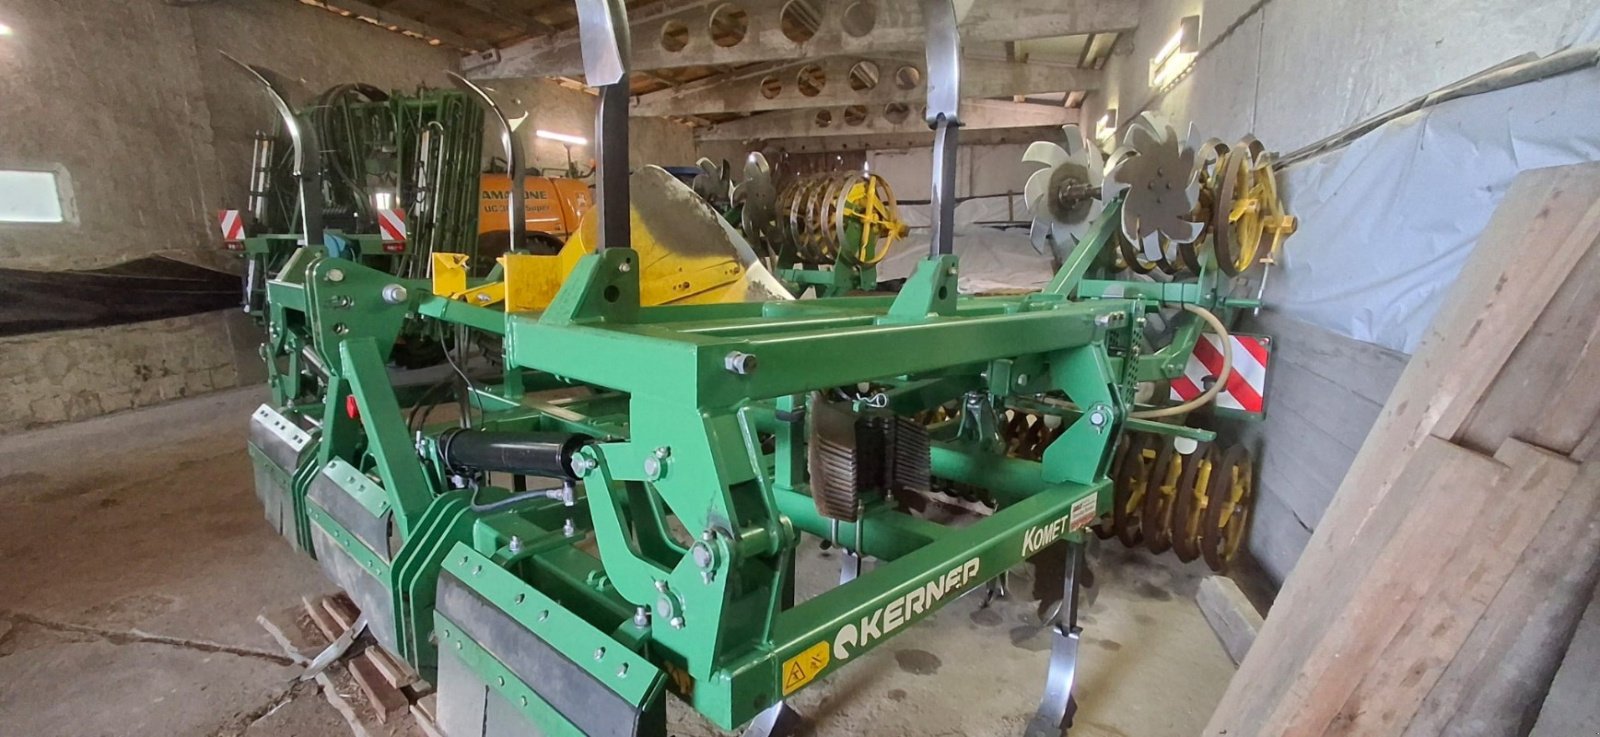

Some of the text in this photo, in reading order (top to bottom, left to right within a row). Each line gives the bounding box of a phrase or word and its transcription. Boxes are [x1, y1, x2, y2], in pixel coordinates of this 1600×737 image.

[482, 190, 548, 200] AMAONE
[1022, 514, 1069, 557] KOMET
[860, 557, 980, 647] KERNER
